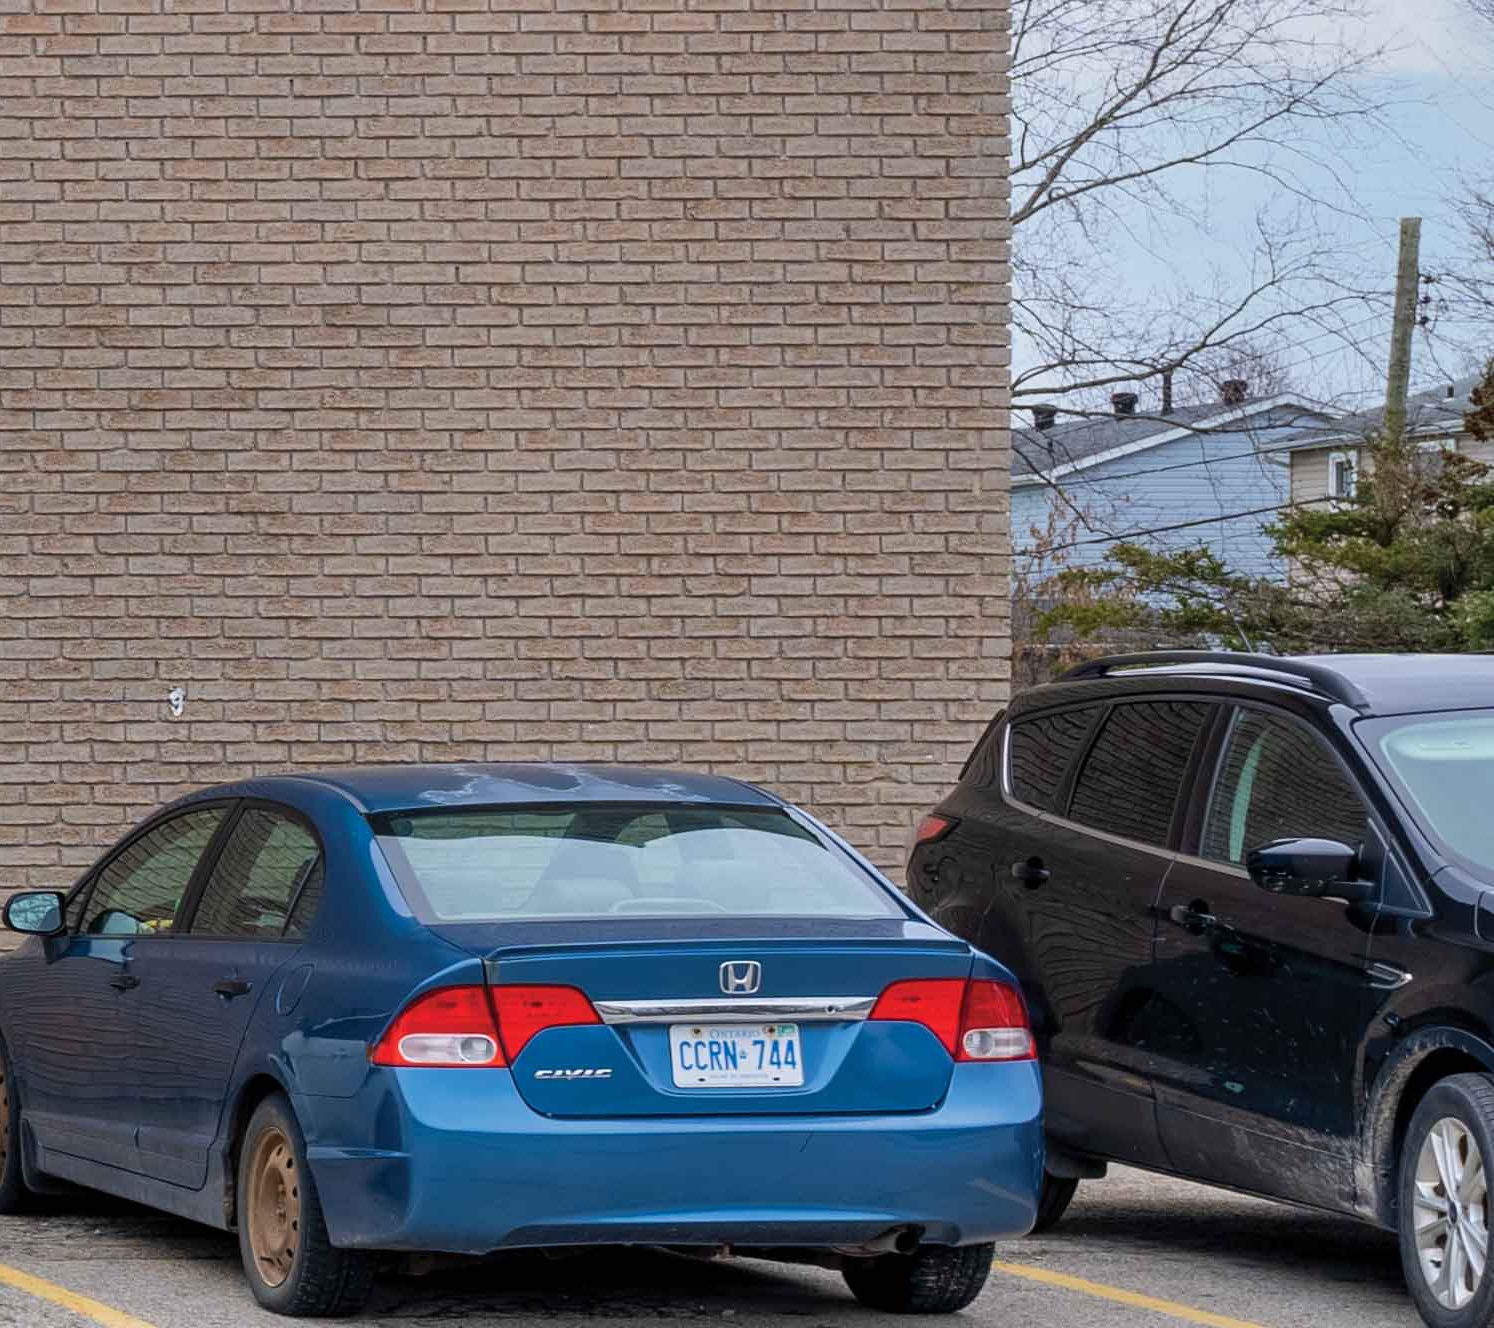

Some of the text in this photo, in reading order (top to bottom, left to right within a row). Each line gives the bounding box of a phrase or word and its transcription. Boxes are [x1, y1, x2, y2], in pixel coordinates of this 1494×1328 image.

[679, 1039, 797, 1071] CCRN 744
[534, 1068, 613, 1080] CIVIC
